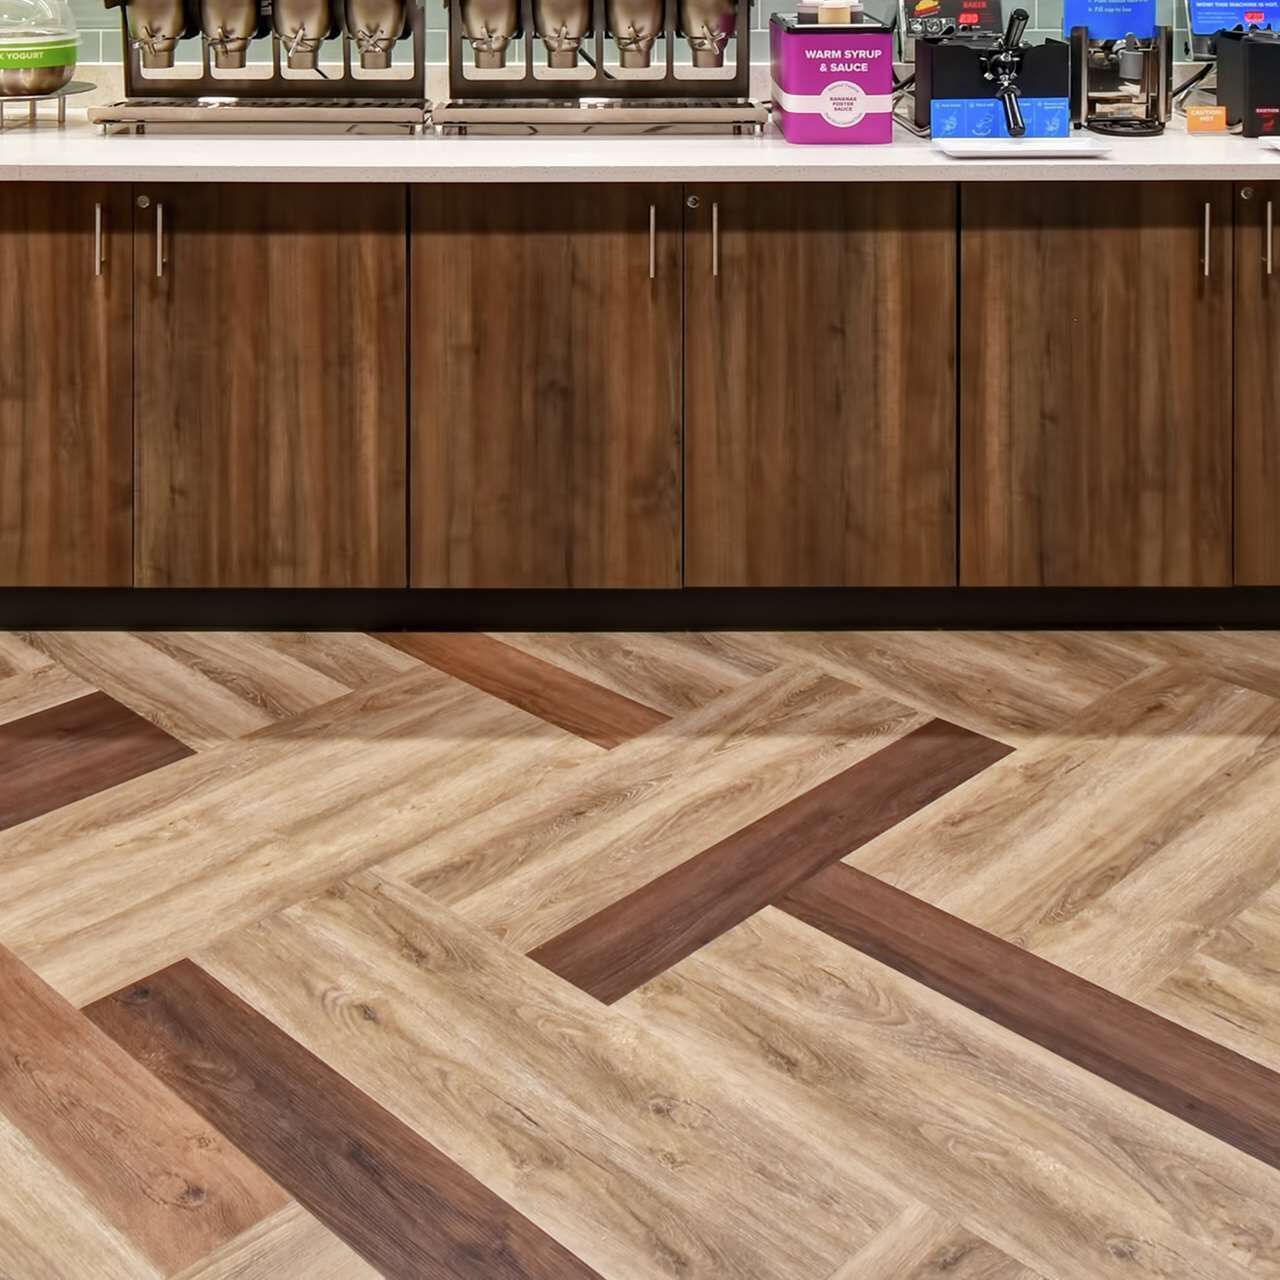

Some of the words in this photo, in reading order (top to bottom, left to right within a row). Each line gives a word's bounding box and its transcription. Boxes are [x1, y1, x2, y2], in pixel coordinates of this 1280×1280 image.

[804, 50, 841, 59] WARM
[843, 49, 882, 59] SYRUP
[819, 63, 827, 72] &
[830, 63, 868, 72] SAUCE
